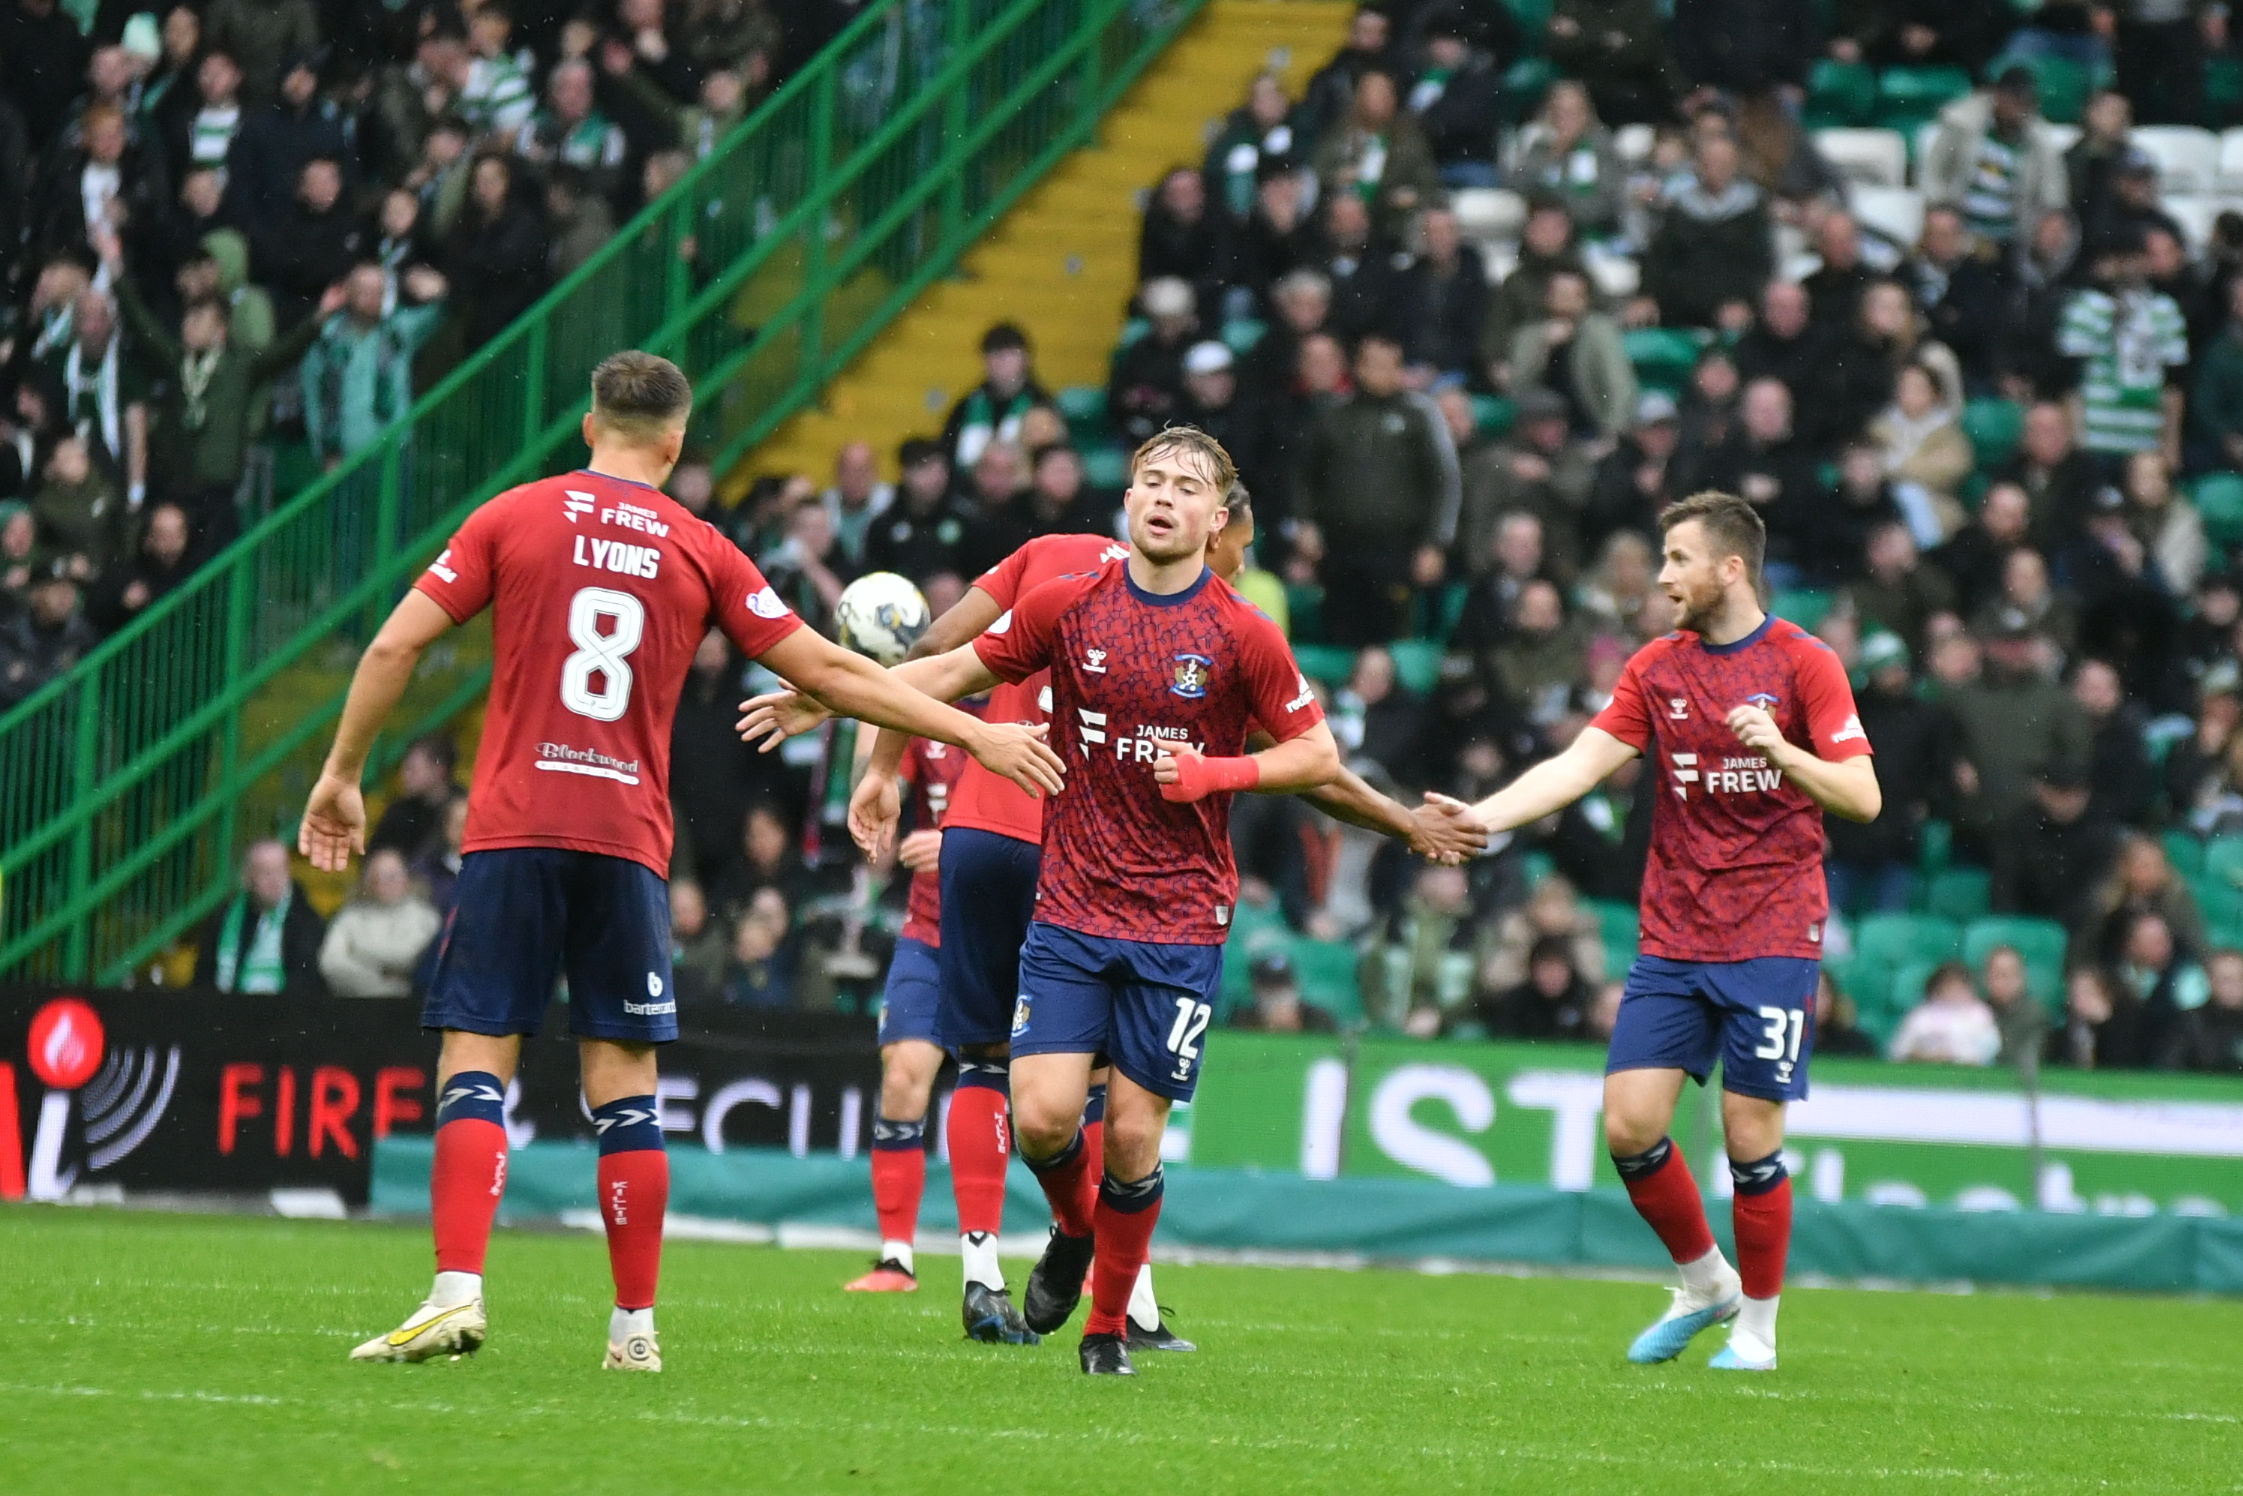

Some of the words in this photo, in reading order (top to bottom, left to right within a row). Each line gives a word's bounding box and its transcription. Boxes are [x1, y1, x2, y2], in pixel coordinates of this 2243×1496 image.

[600, 508, 670, 538] FREW
[617, 502, 658, 520] JAMES
[572, 534, 662, 580] LYONS
[559, 586, 645, 722] 8
[1136, 724, 1189, 740] JAMES
[1723, 756, 1768, 770] JAMES
[1706, 768, 1783, 795] FREW
[1166, 997, 1213, 1060] 12
[1755, 1005, 1805, 1064] 31
